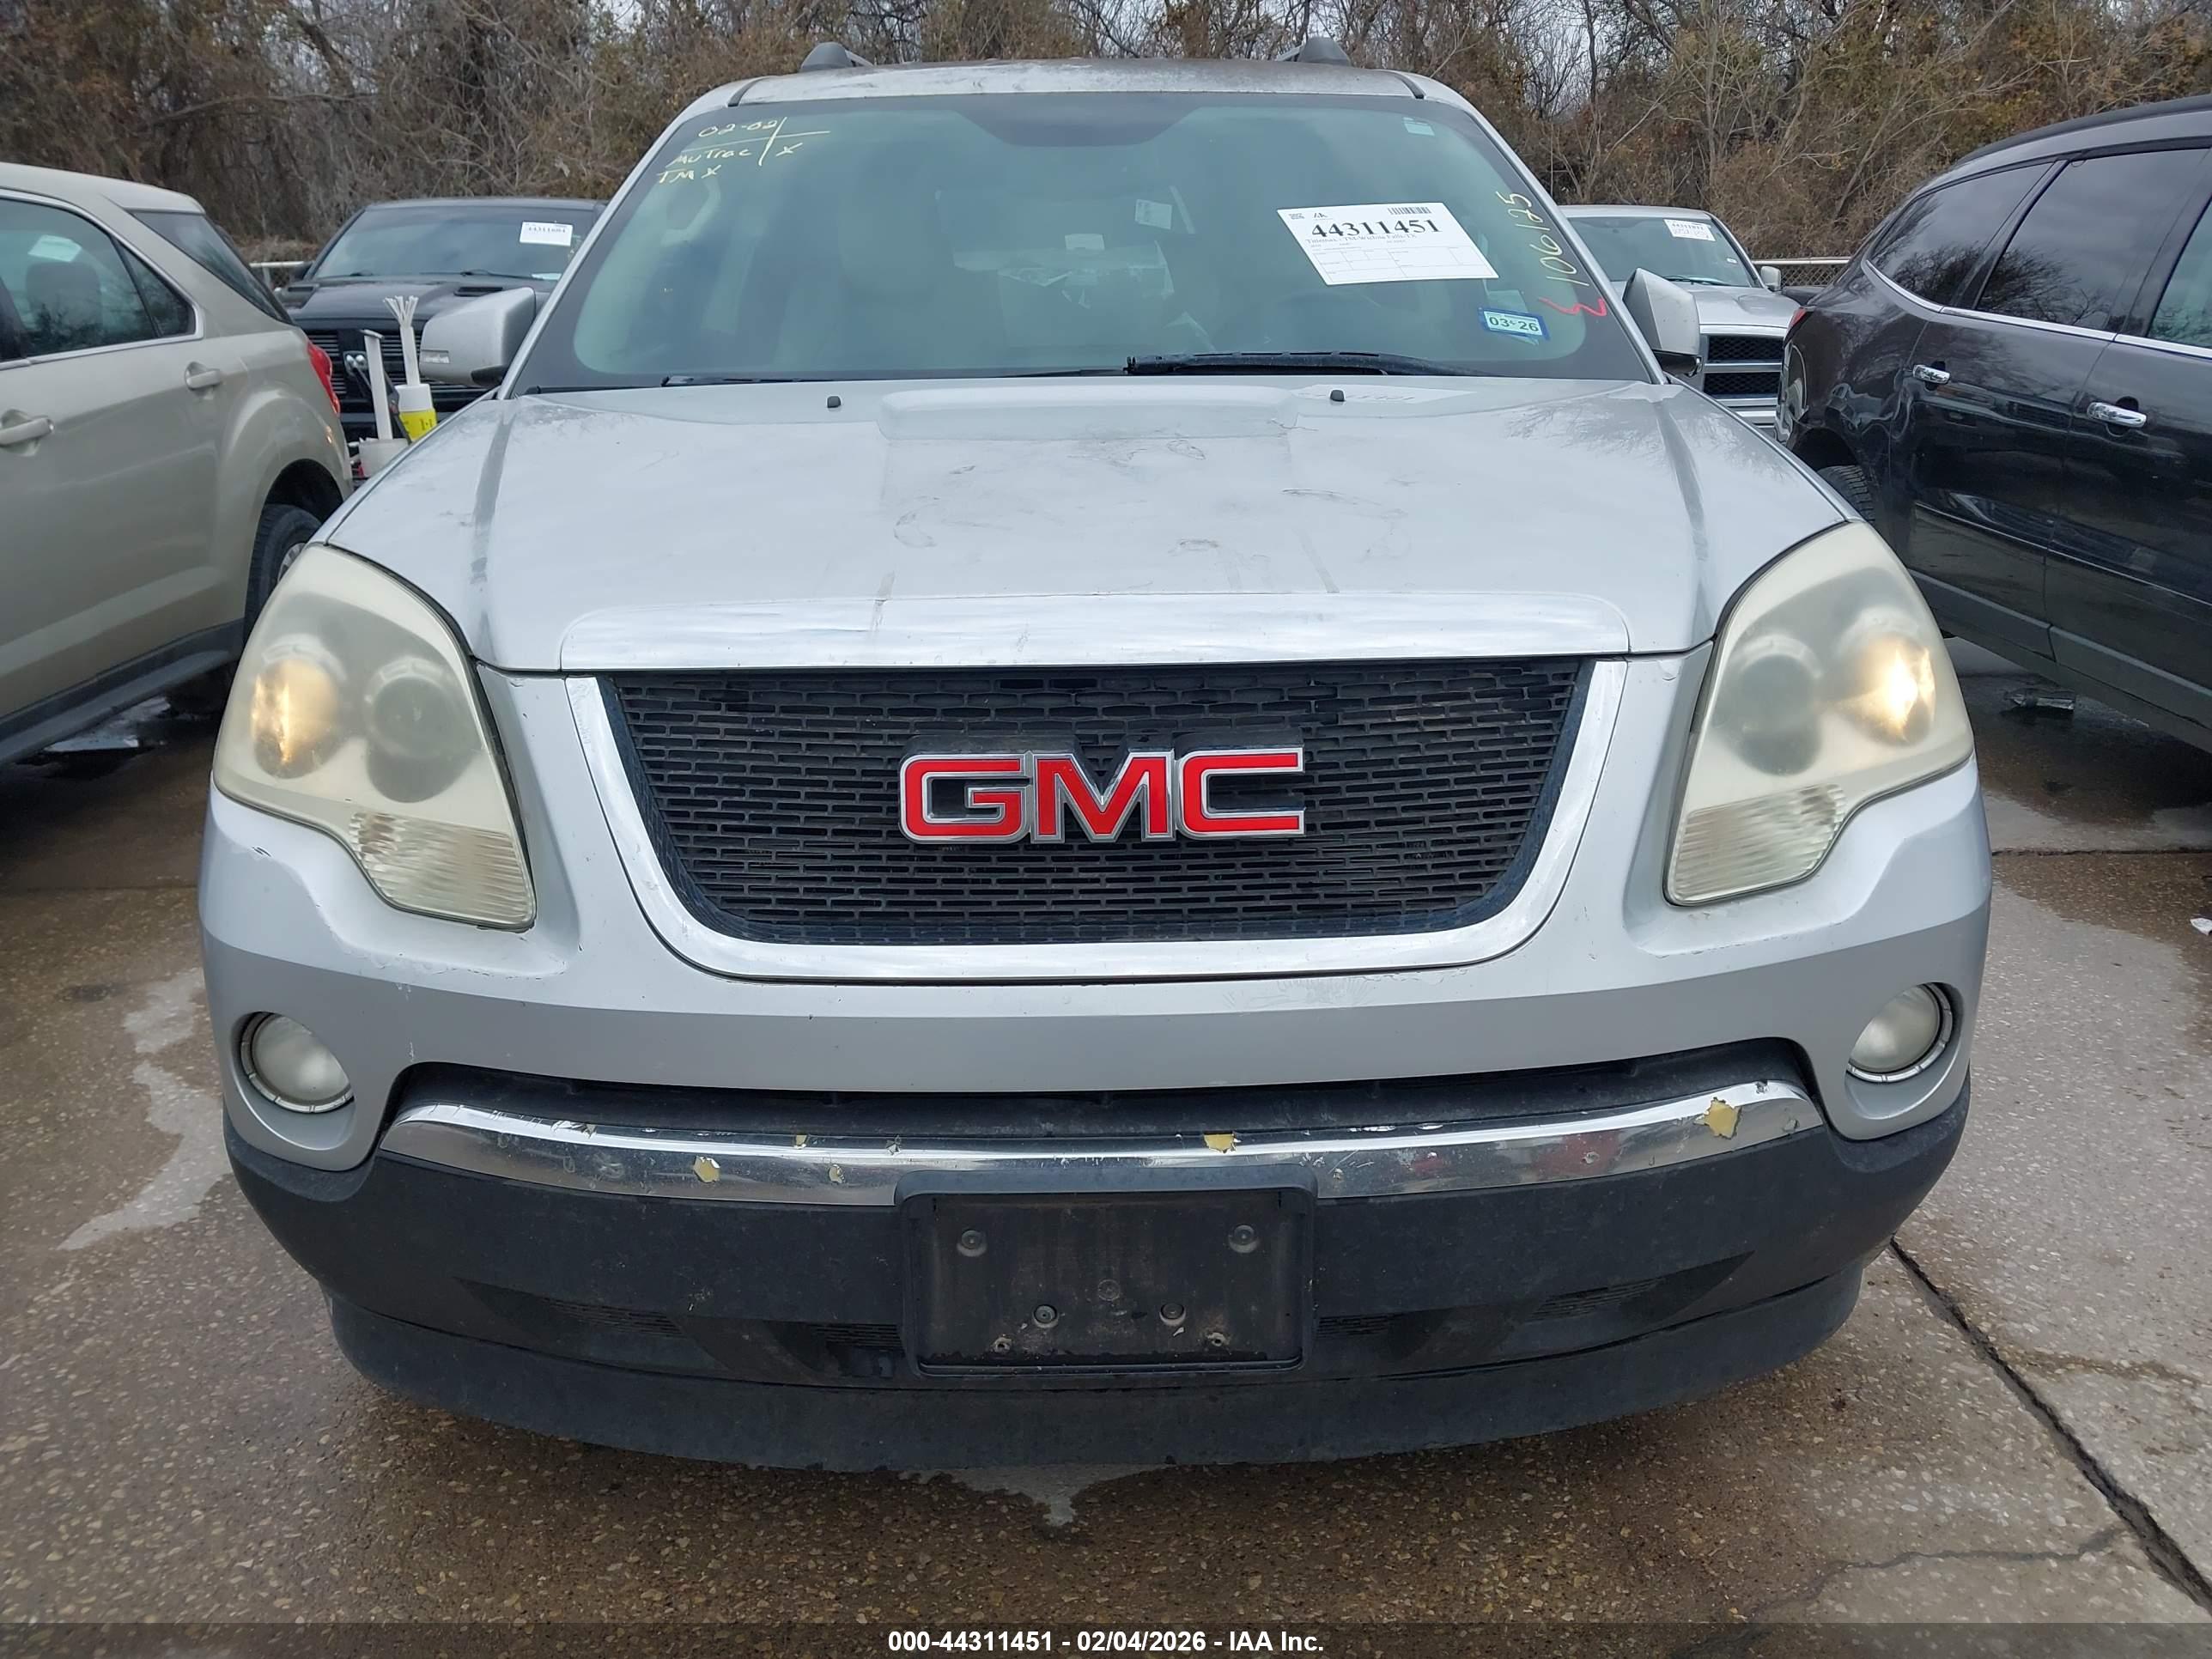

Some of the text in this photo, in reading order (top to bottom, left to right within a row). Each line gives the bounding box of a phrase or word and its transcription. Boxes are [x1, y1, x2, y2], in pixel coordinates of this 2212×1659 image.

[1311, 219, 1442, 237] 44311451
[1496, 191, 1589, 286] 106125
[1489, 316, 1540, 332] 03 26
[900, 747, 1305, 844] GMC
